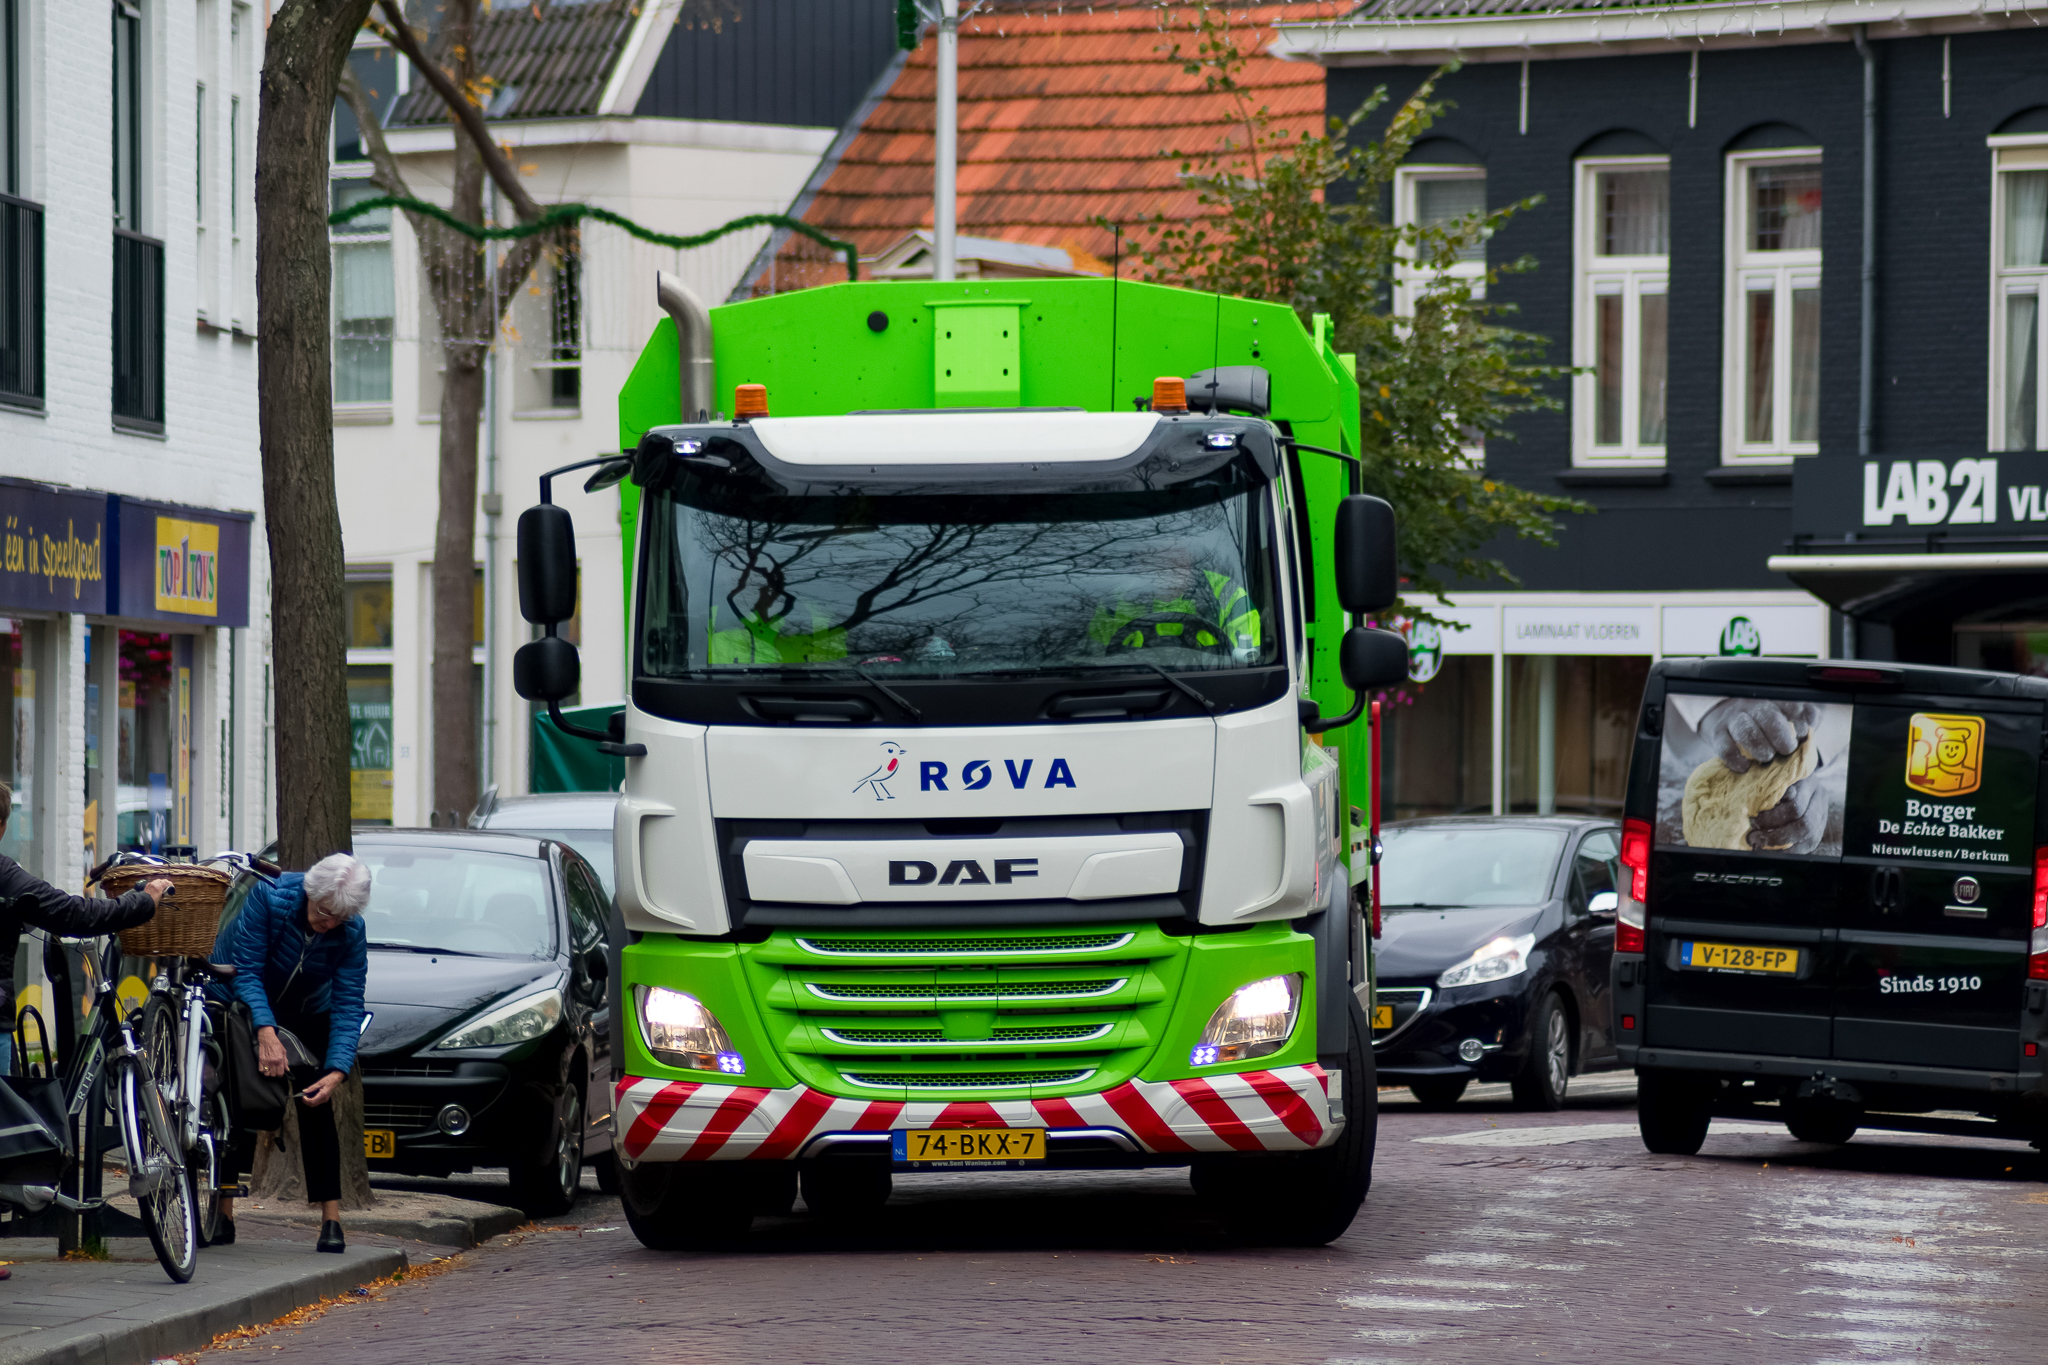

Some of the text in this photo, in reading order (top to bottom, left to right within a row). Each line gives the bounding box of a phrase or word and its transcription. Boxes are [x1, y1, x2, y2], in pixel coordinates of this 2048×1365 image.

[1864, 458, 2048, 526] LAB21 VL
[29, 526, 40, 575] in
[158, 534, 214, 603] TOP 1 TOYS
[1517, 623, 1640, 640] LAMINAAT VLOEREN
[1724, 619, 1759, 651] LAB
[1906, 799, 1976, 823] Borger
[1879, 819, 2005, 841] De Echte Bakker
[1872, 843, 2010, 862] Nieuwleusen/Berkum
[888, 858, 1039, 886] DAF
[1693, 872, 1783, 887] DUCATO
[1960, 885, 1975, 898] FIAT
[1703, 946, 1788, 969] V-128-FP
[1880, 975, 1982, 994] Sinds 1910
[77, 1071, 94, 1100] RIH
[894, 1133, 1035, 1156] NL 74-BKX-7
